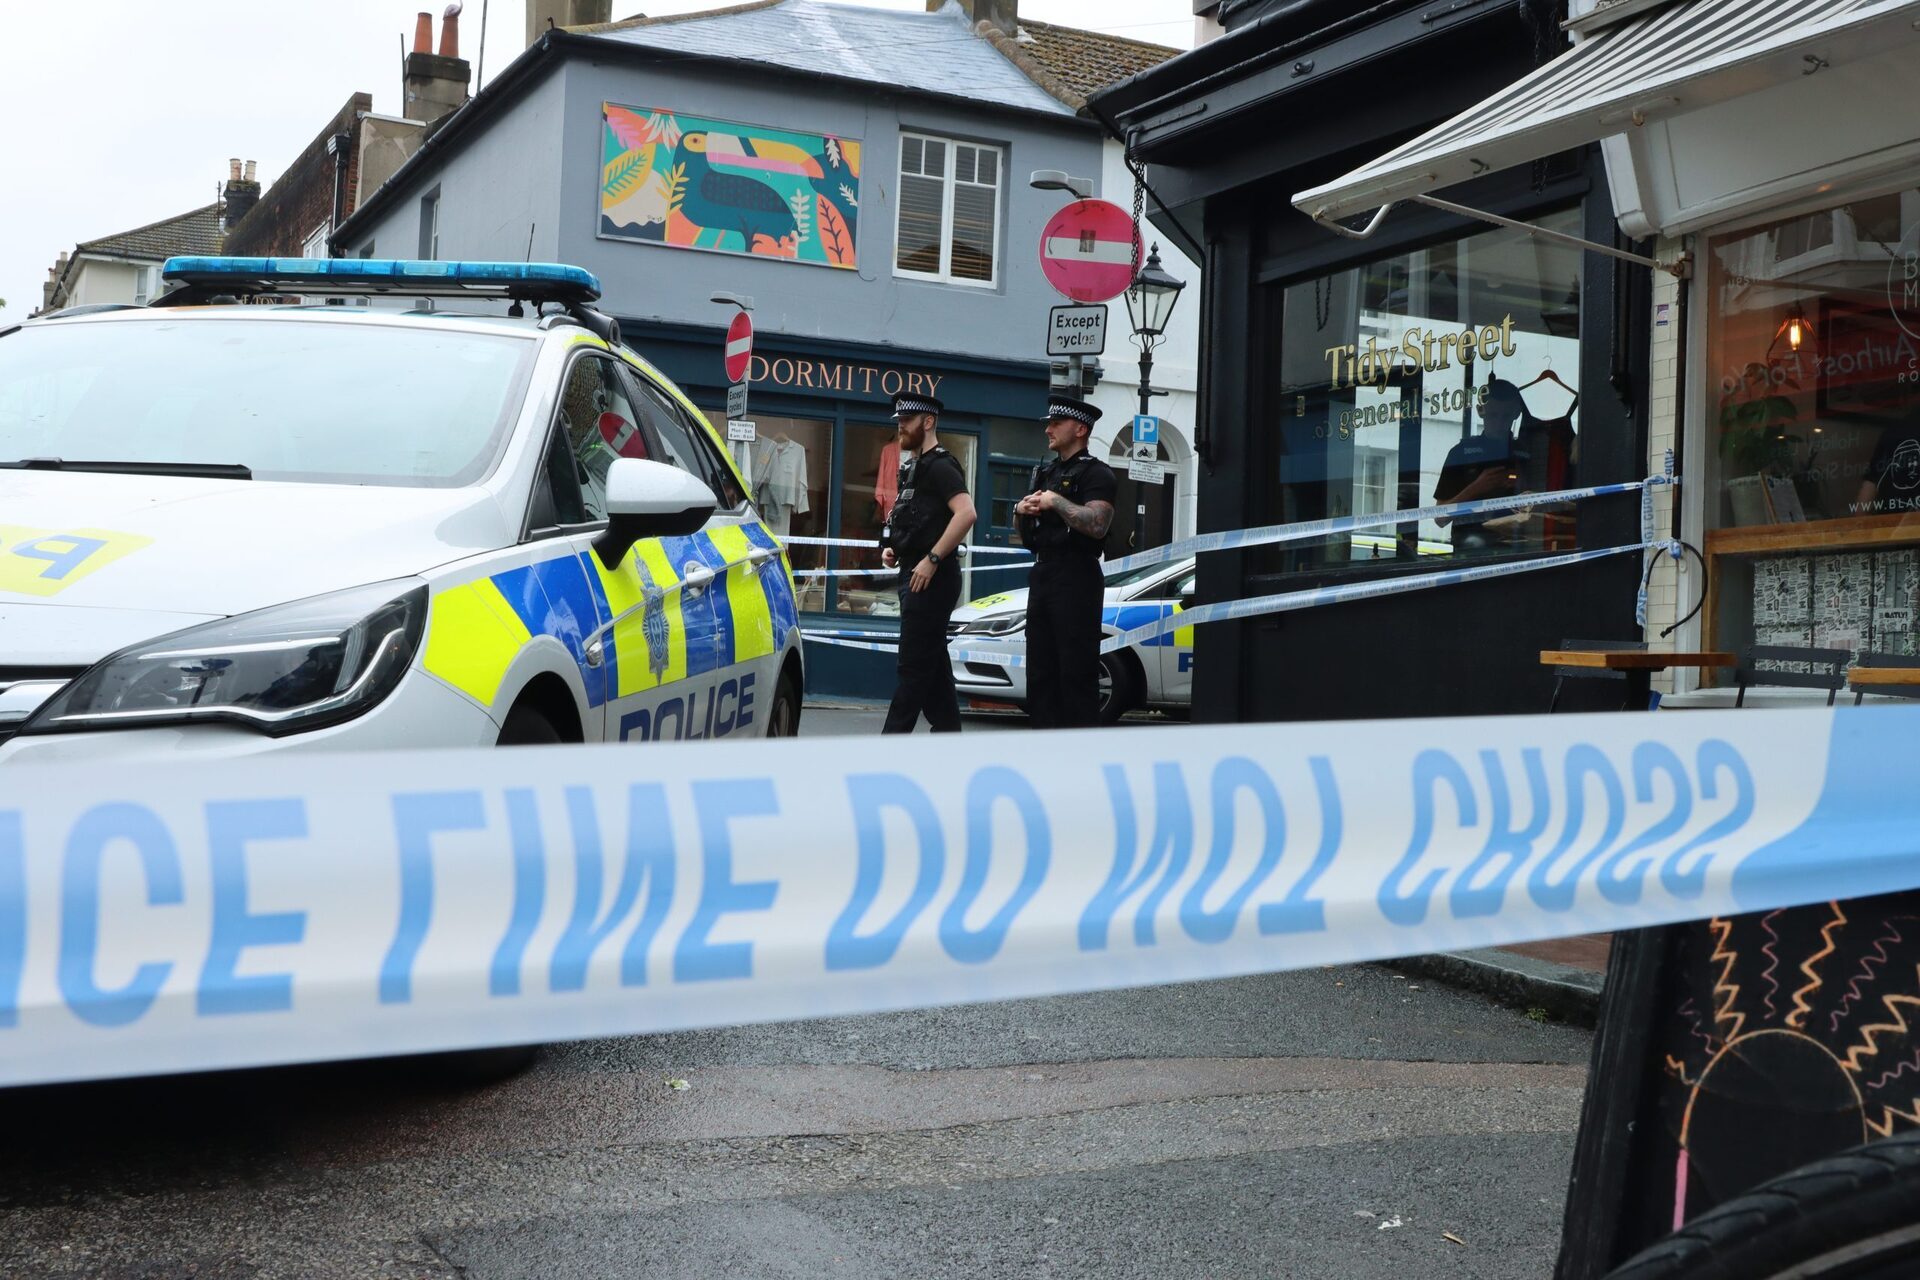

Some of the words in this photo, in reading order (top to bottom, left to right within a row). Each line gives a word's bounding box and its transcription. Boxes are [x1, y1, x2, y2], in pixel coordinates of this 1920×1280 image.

[1056, 313, 1101, 330] Except
[749, 354, 943, 397] DORMITORY
[1324, 335, 1399, 395] Tidy
[1401, 312, 1517, 377] Street
[1139, 418, 1155, 440] P
[1338, 388, 1419, 441] general
[1429, 383, 1490, 416] store
[618, 671, 756, 743] POLICE
